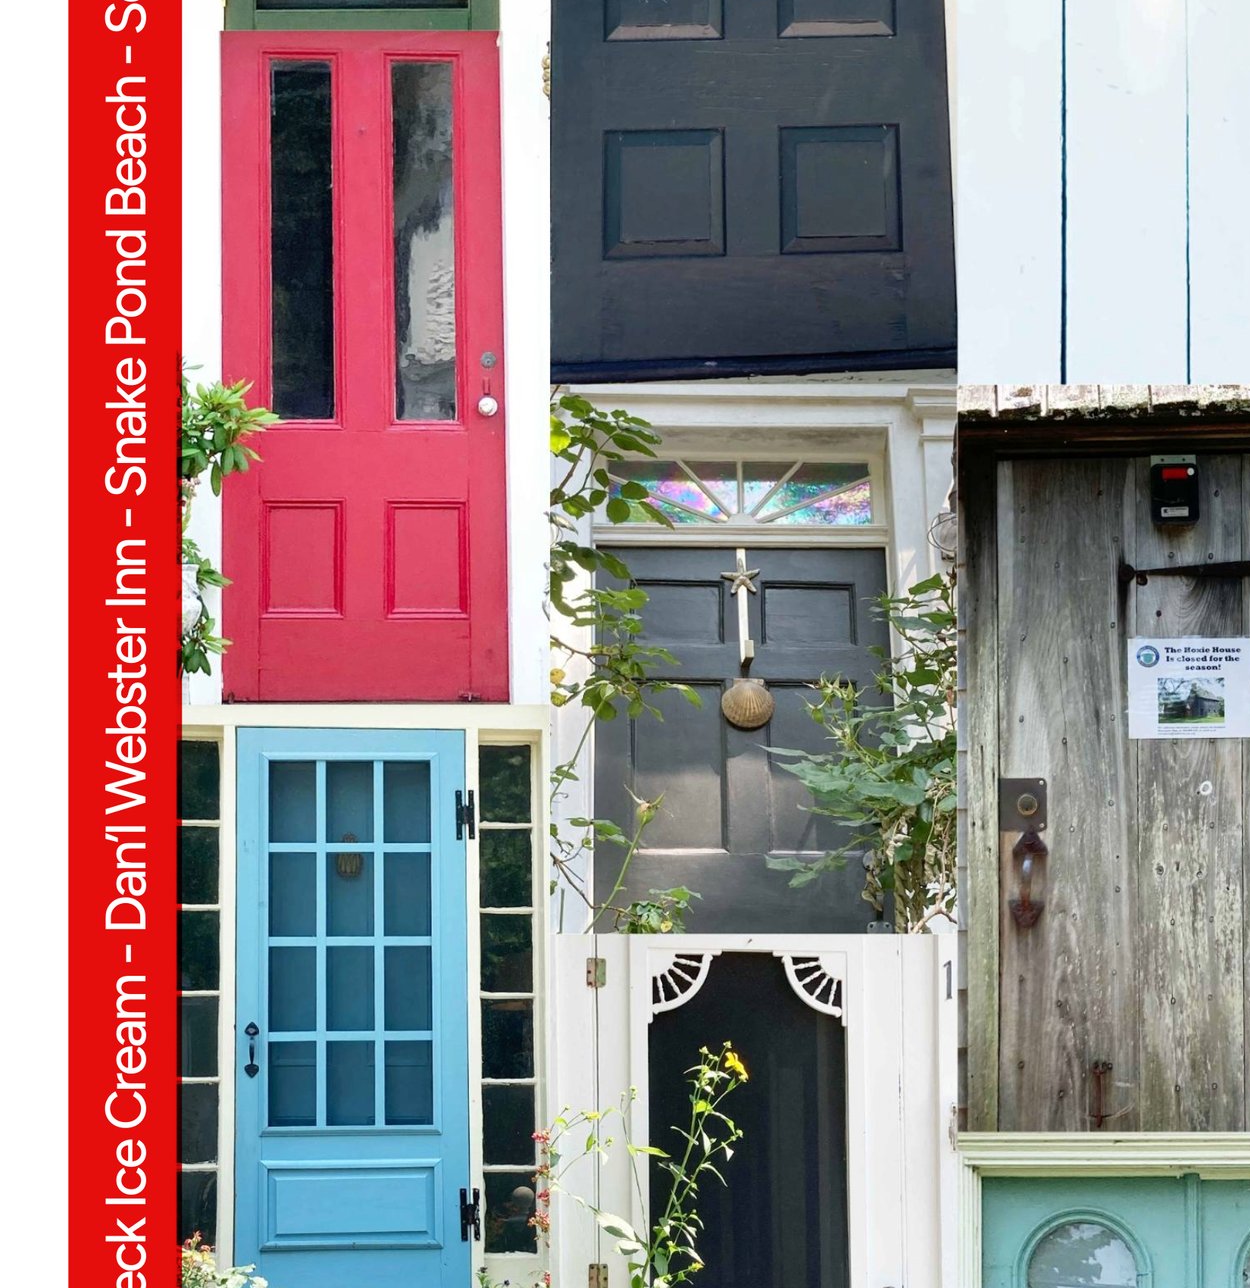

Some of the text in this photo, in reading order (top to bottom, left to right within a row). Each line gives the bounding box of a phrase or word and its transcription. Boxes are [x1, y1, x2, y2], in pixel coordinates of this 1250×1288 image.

[105, 76, 147, 215] Beach
[105, 230, 147, 345] Pond
[104, 357, 147, 496] Snake
[105, 539, 147, 606] Inn
[104, 617, 147, 815] Webster
[104, 825, 147, 930] Dan’l
[943, 960, 953, 1000] 1
[104, 975, 147, 1129] Cream
[105, 1139, 147, 1205] Ice
